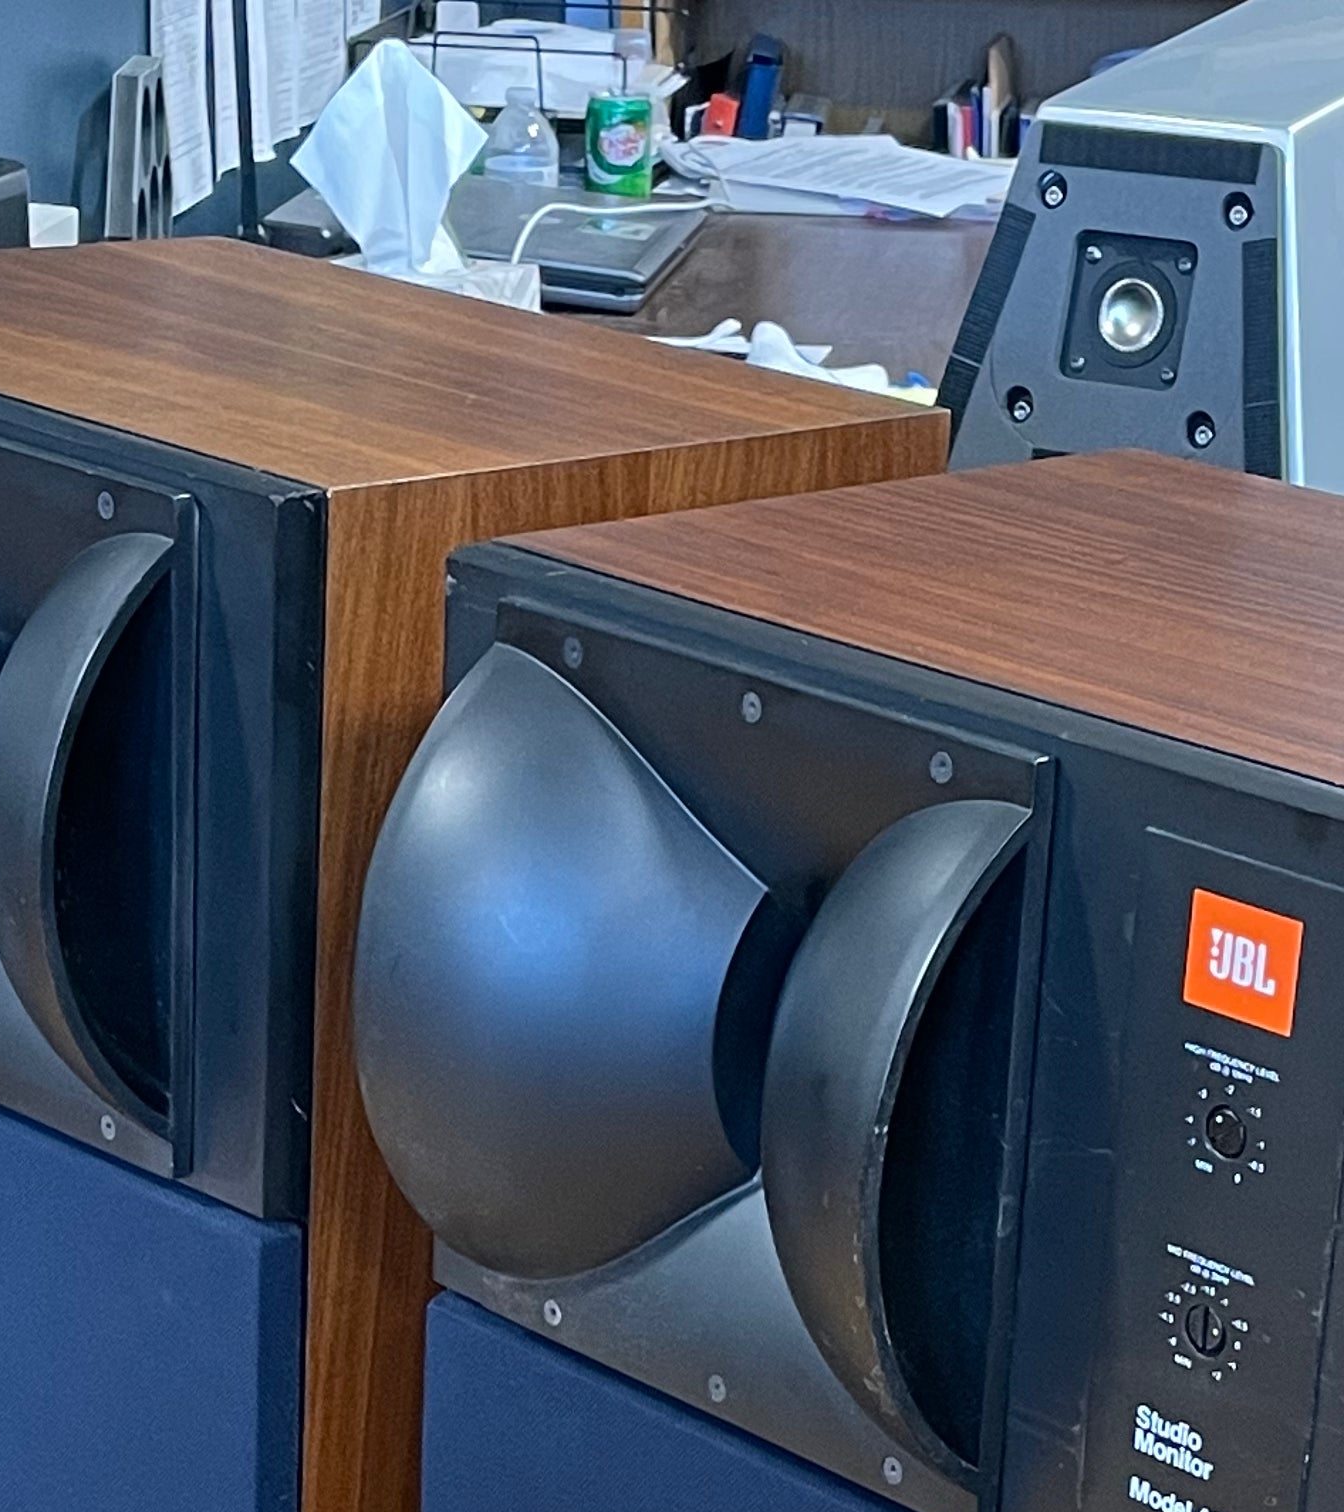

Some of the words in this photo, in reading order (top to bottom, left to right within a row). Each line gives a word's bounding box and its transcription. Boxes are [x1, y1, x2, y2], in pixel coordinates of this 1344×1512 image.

[1209, 928, 1276, 996] JBL
[1134, 1427, 1214, 1480] Monitor
[1136, 1405, 1203, 1451] Studio
